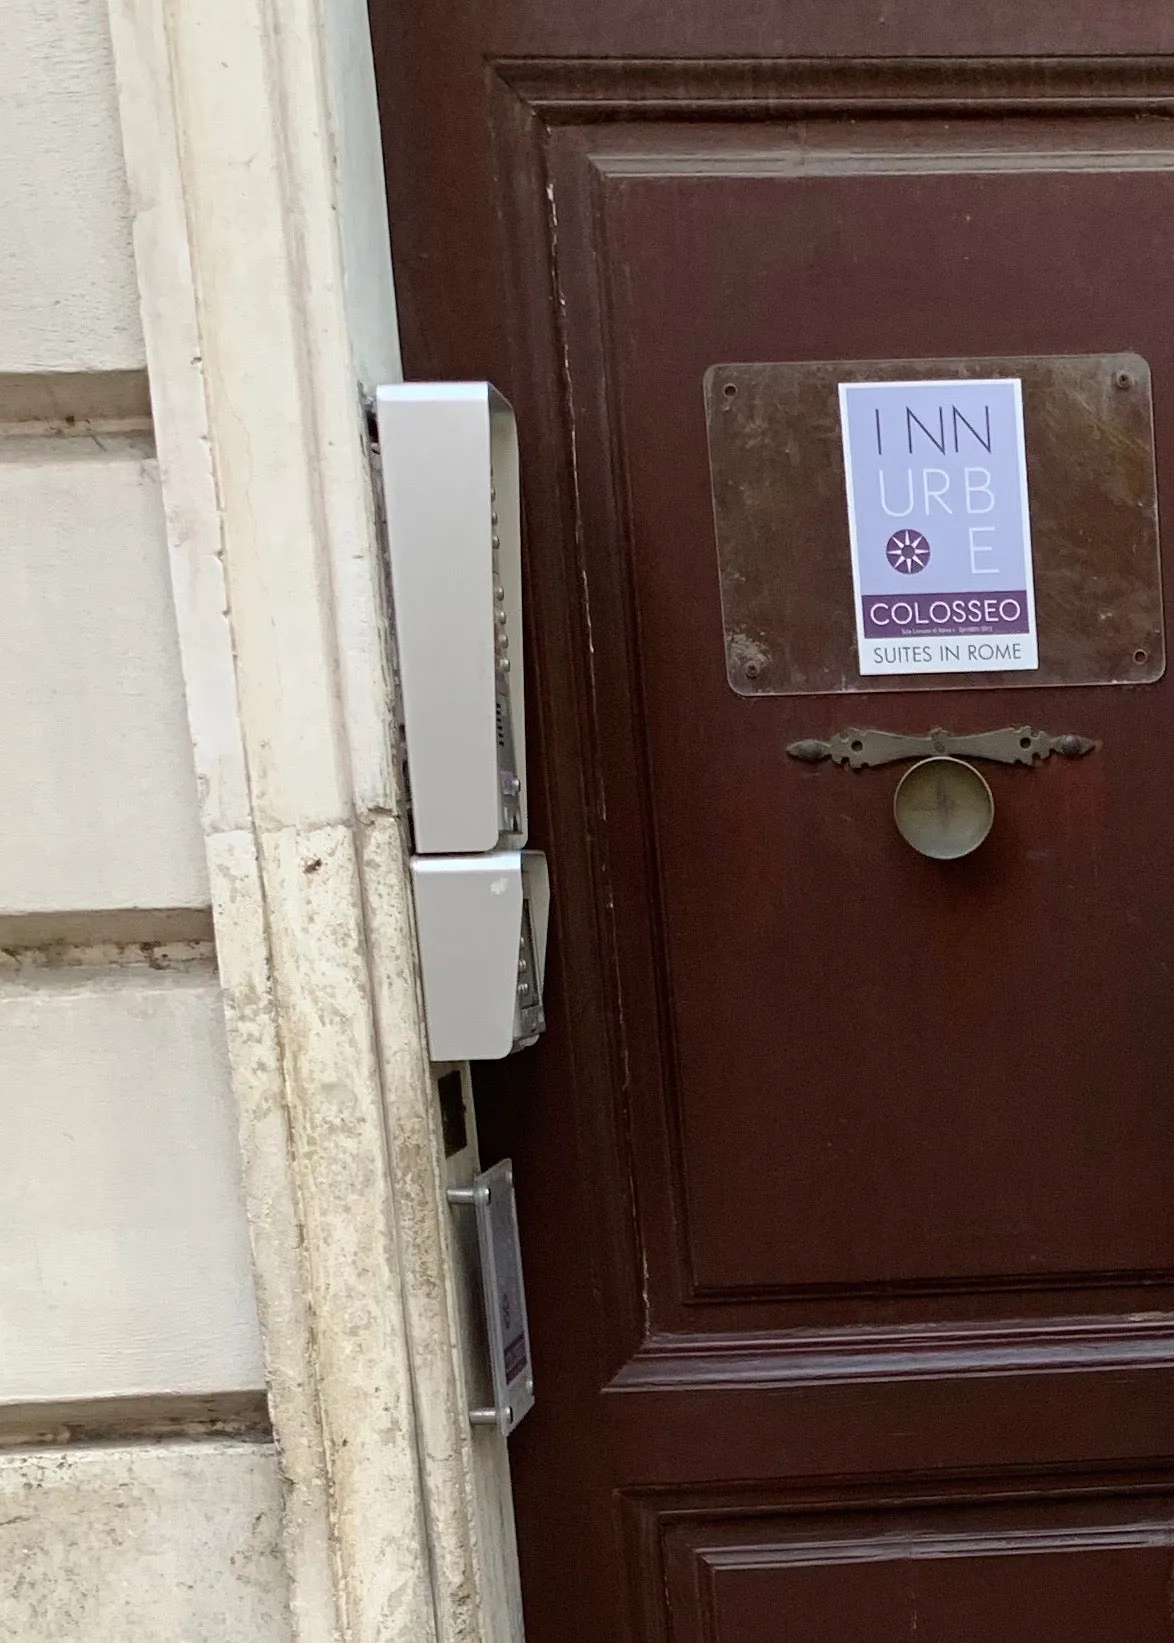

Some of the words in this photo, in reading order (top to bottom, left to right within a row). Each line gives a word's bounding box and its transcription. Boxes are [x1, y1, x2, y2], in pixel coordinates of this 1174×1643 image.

[875, 405, 992, 456] INN
[870, 598, 1021, 626] COLOSSEO
[873, 645, 932, 664] SUITES
[939, 644, 960, 662] IN
[968, 642, 1022, 661] ROME
